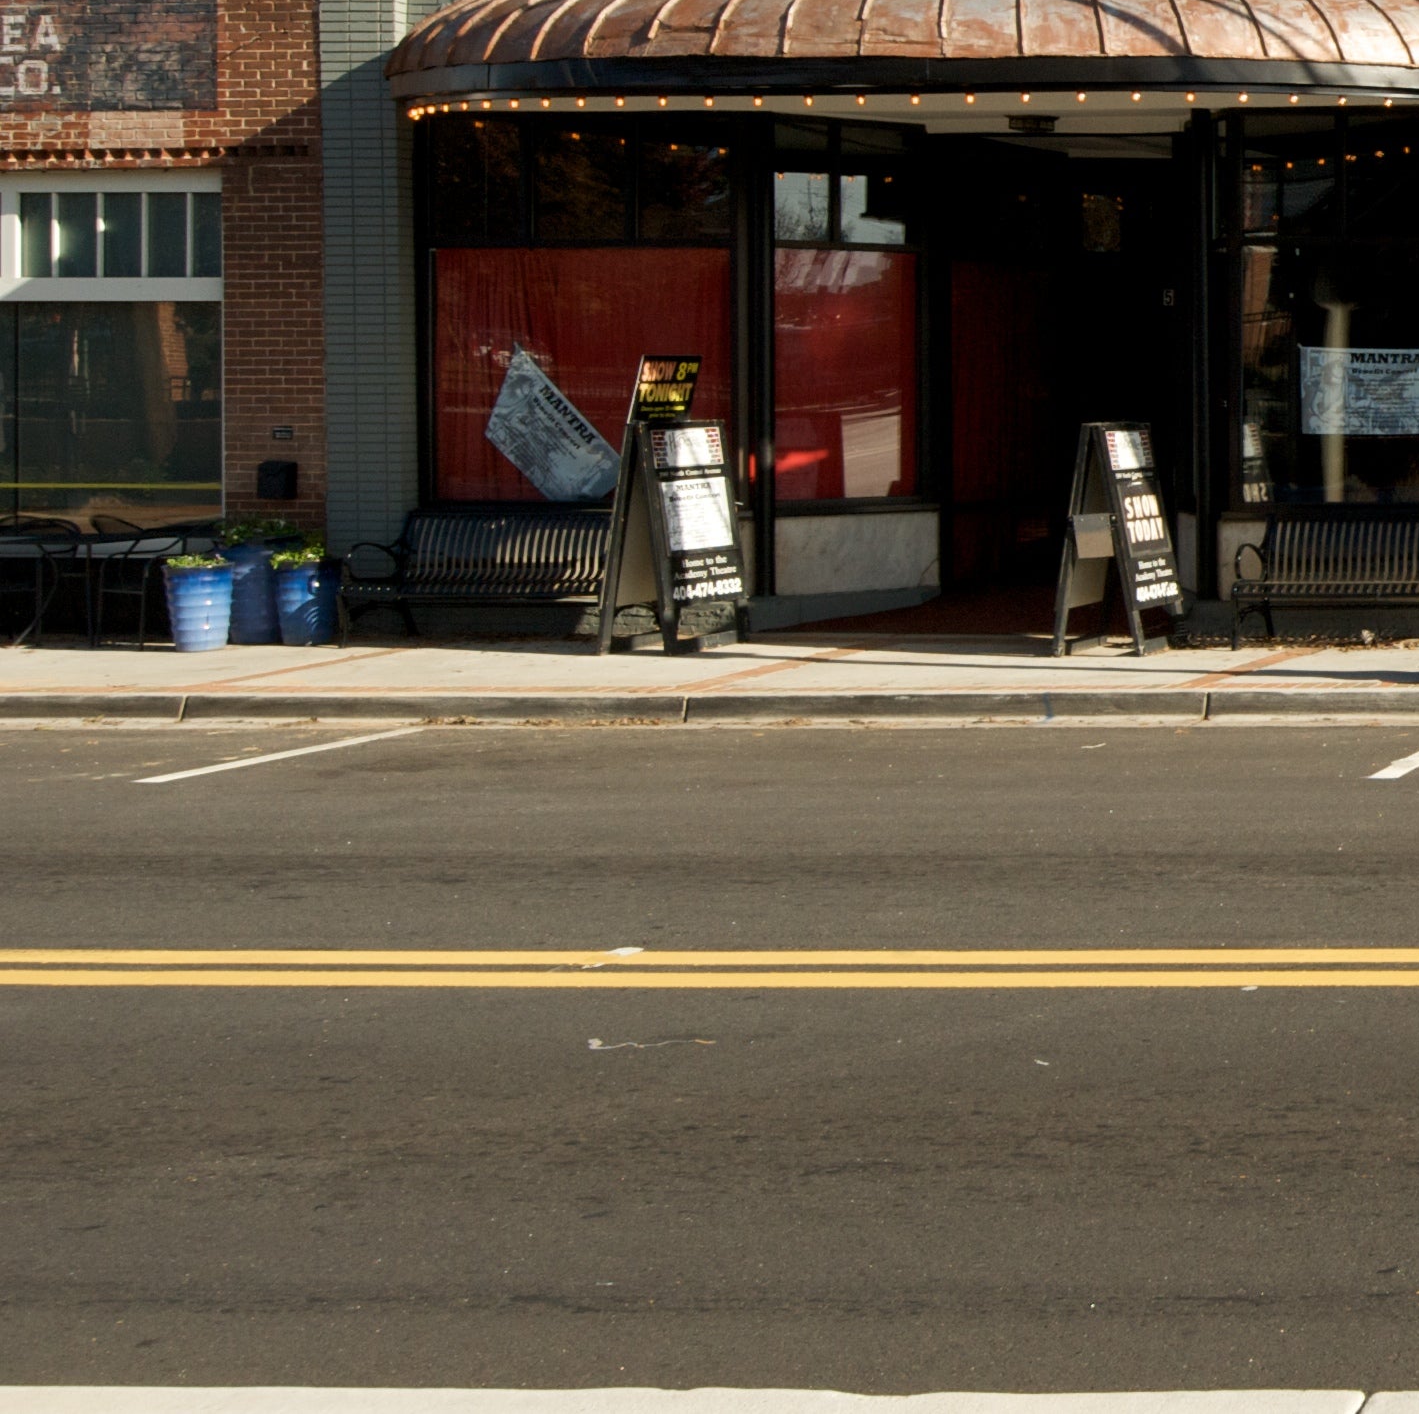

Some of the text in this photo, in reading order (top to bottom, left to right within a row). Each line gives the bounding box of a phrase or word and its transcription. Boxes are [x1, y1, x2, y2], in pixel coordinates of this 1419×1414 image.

[641, 361, 678, 382] SHOW
[639, 382, 694, 402] TONIGHT
[539, 384, 596, 445] MANTRA
[1124, 494, 1160, 520] SHOW
[1127, 517, 1164, 543] TODAY
[705, 557, 714, 565] to
[715, 554, 728, 564] the
[673, 577, 743, 601] 404-474-8332
